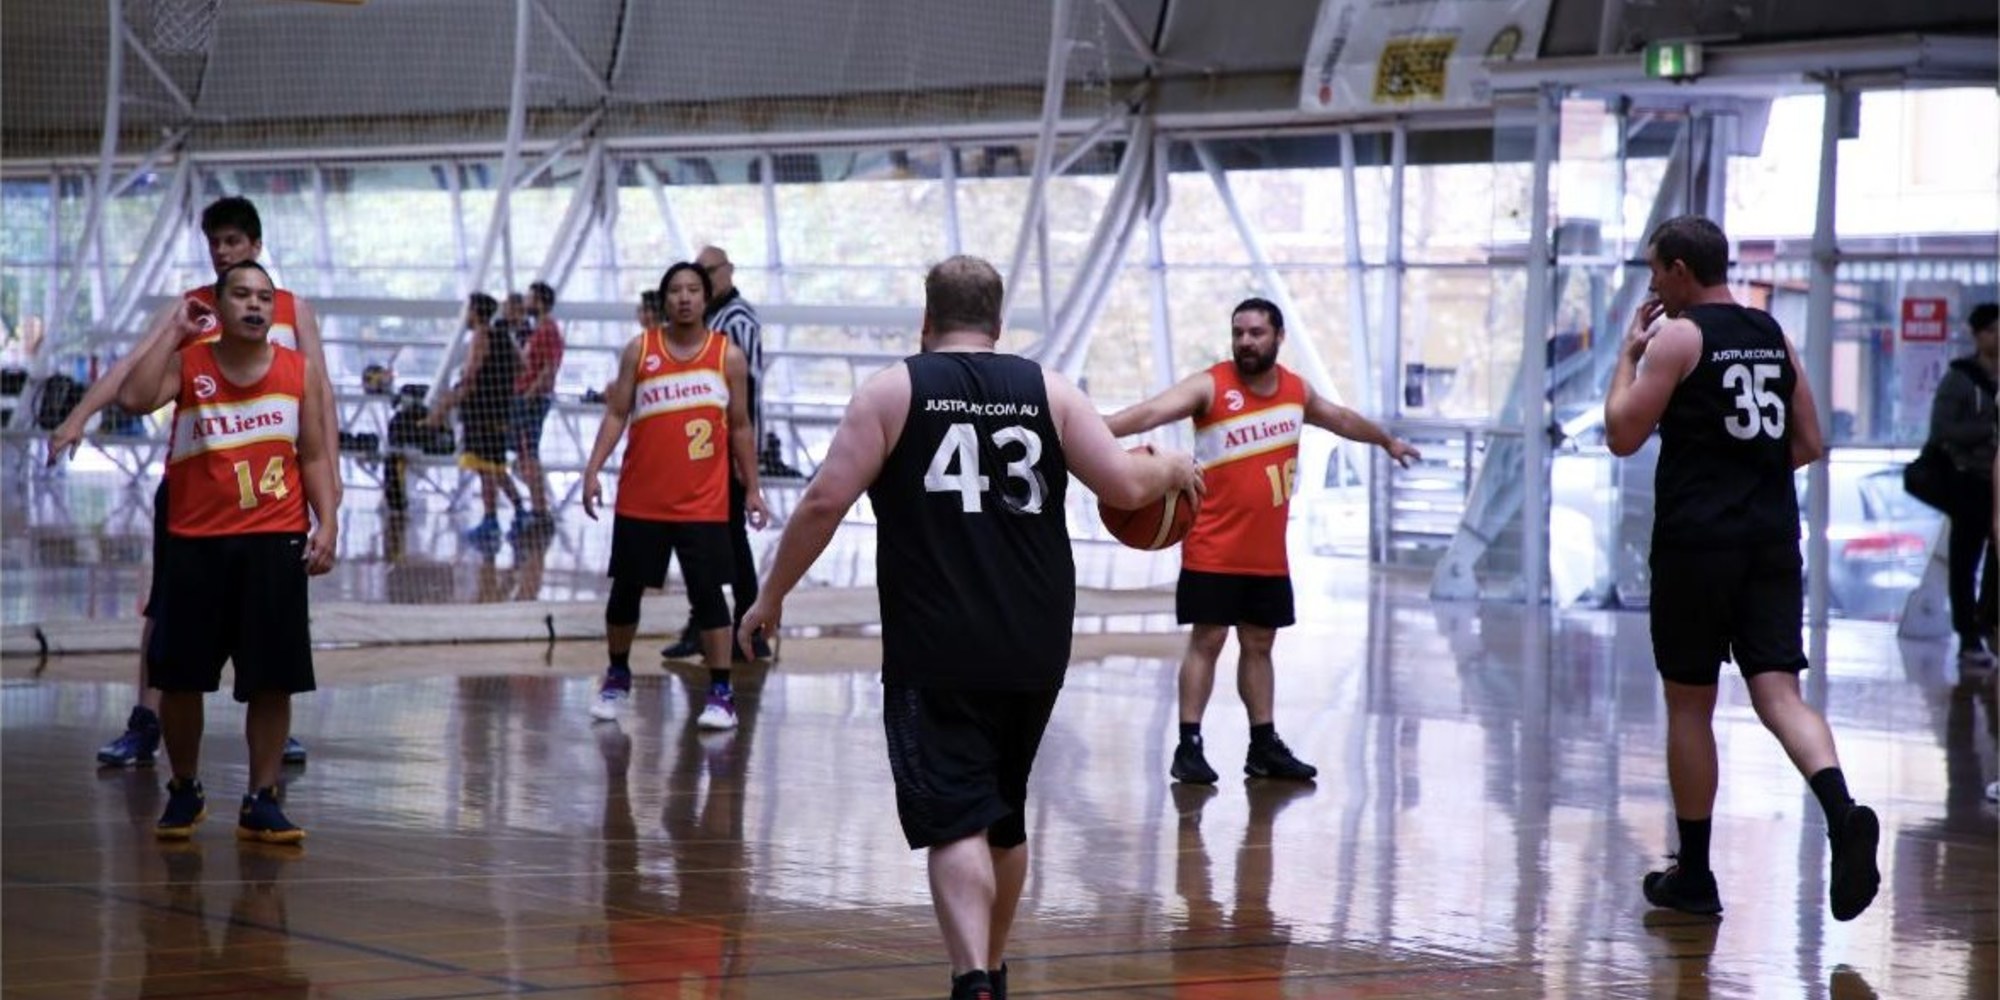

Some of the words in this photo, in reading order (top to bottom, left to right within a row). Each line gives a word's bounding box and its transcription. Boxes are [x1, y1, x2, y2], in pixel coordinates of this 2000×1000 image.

[641, 382, 713, 406] ATLiens
[1722, 363, 1786, 440] 35
[192, 410, 284, 440] ATLiens
[685, 418, 715, 460] 2
[1224, 420, 1296, 449] ATLiens
[234, 456, 289, 510] 14
[924, 423, 1049, 515] 43
